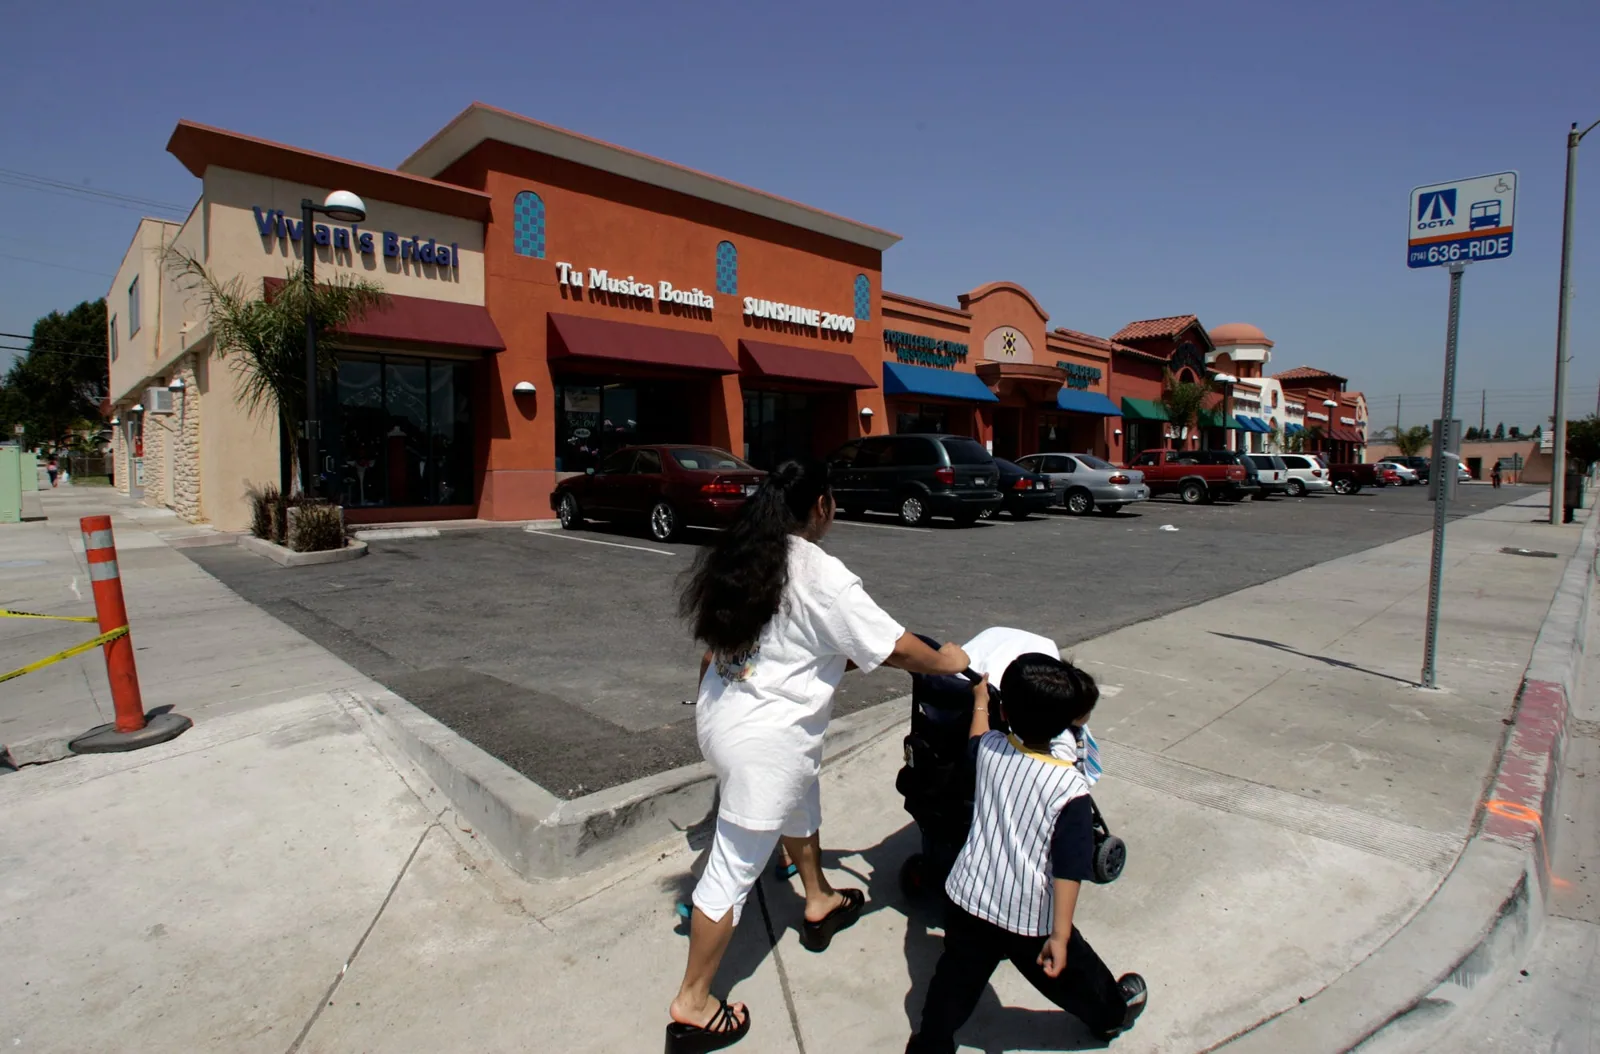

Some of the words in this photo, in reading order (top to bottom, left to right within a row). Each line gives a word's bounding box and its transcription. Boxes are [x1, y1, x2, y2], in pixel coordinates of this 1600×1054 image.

[252, 205, 375, 254] Vivan's
[382, 231, 460, 268] Bridal
[1417, 218, 1455, 230] OCTA
[1428, 237, 1509, 262] 636-RIDE
[556, 261, 583, 287] Tu
[588, 267, 655, 300] Musica
[658, 280, 714, 309] Bonita
[743, 296, 820, 328] SUNSHINE
[820, 311, 856, 333] 2000
